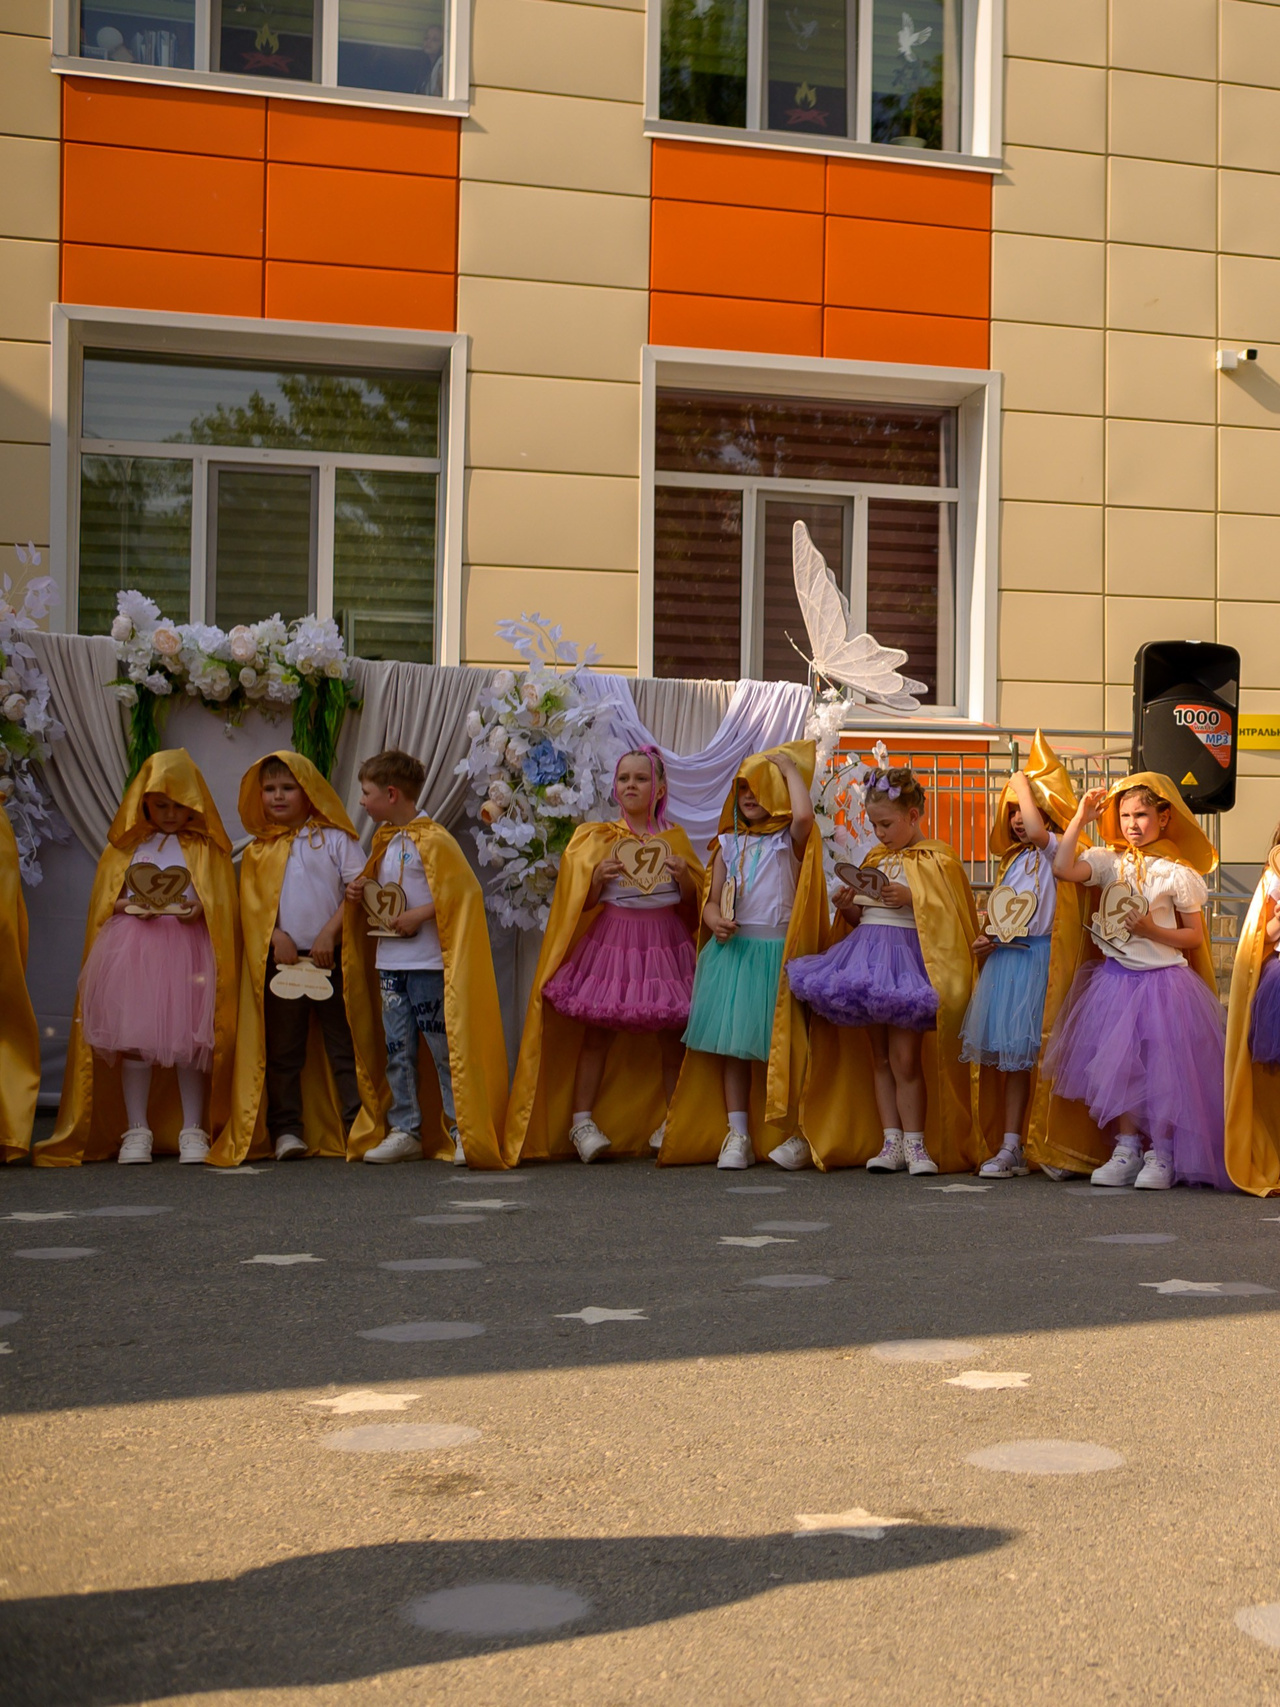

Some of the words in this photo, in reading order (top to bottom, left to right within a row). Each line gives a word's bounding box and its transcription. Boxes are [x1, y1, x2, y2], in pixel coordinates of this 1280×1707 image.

[1173, 708, 1220, 726] 1000
[1205, 734, 1229, 745] MP3
[632, 846, 661, 875] Я
[146, 872, 181, 895] Я
[856, 872, 878, 891] Я
[376, 889, 397, 916] Я
[999, 896, 1030, 925] Я
